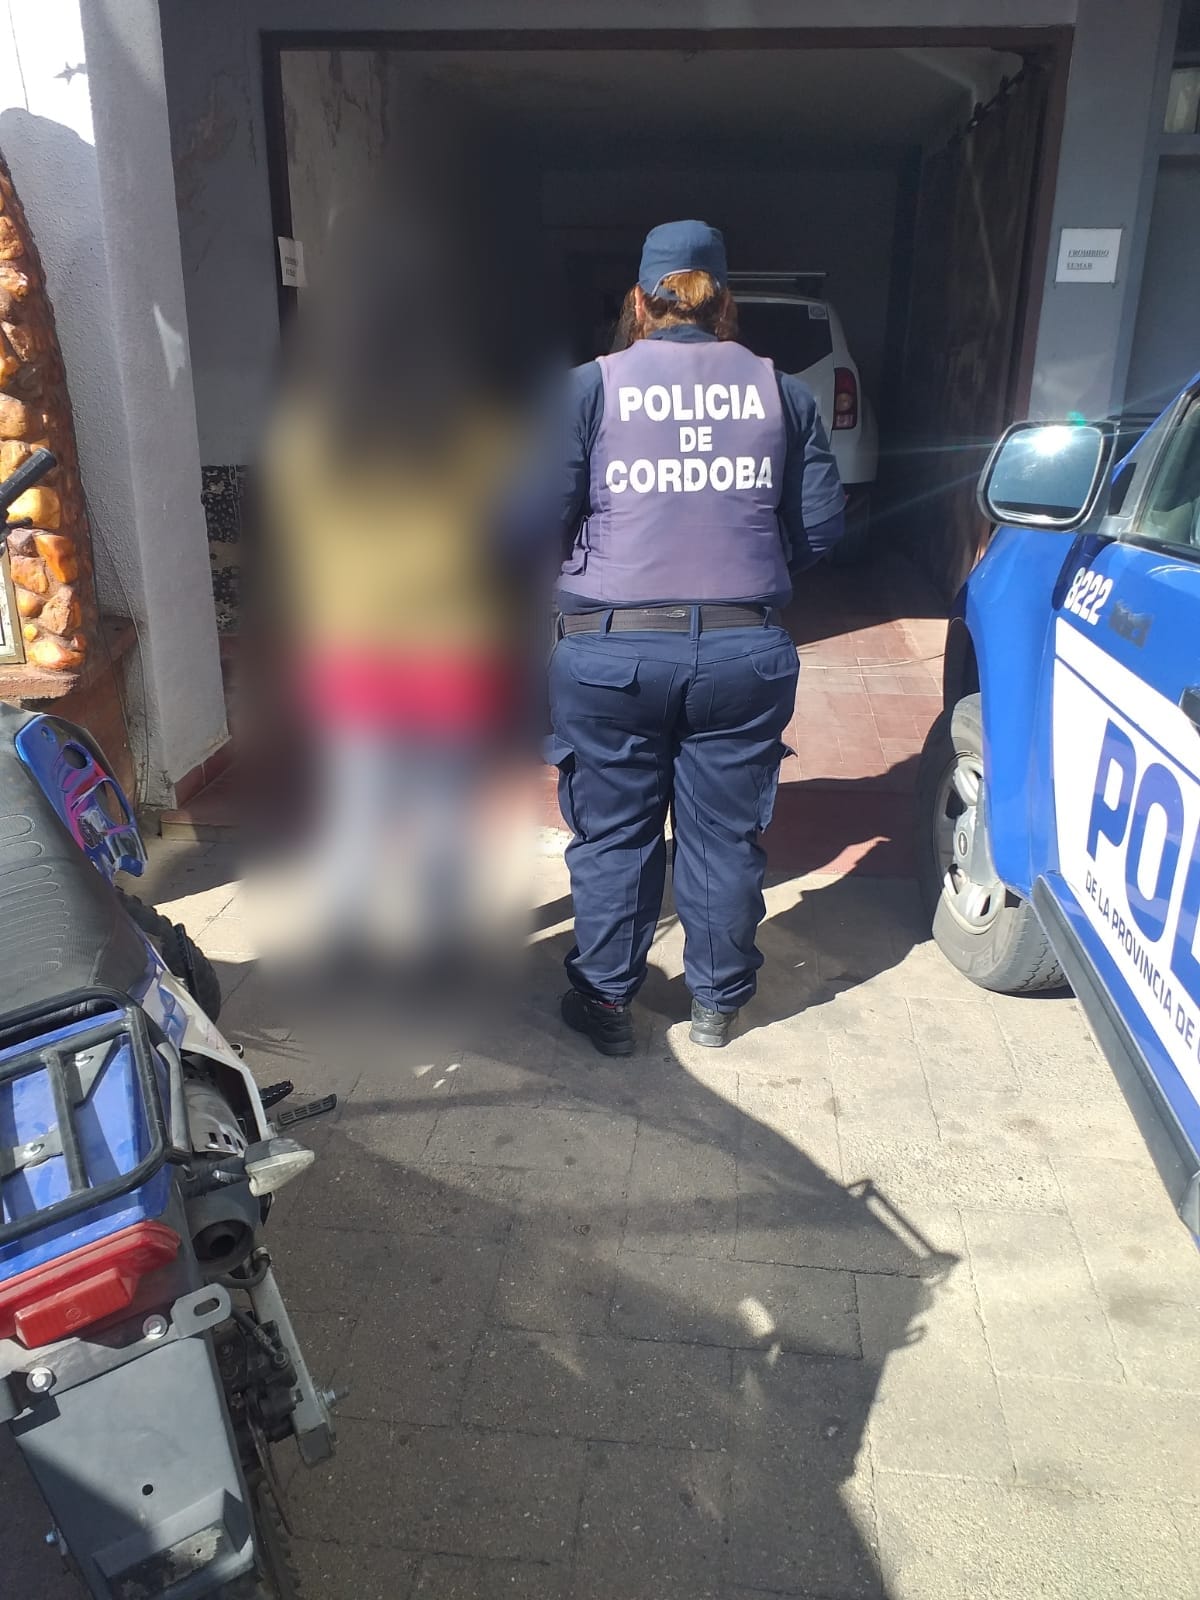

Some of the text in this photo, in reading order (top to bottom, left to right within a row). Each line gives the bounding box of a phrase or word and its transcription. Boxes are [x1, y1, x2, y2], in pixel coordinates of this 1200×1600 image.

[618, 384, 766, 422] POLICIA
[679, 426, 713, 453] DE
[605, 456, 773, 494] CORDOBA
[1063, 567, 1113, 626] 8222
[1085, 869, 1195, 1050] DE LA PROVINCIA DE
